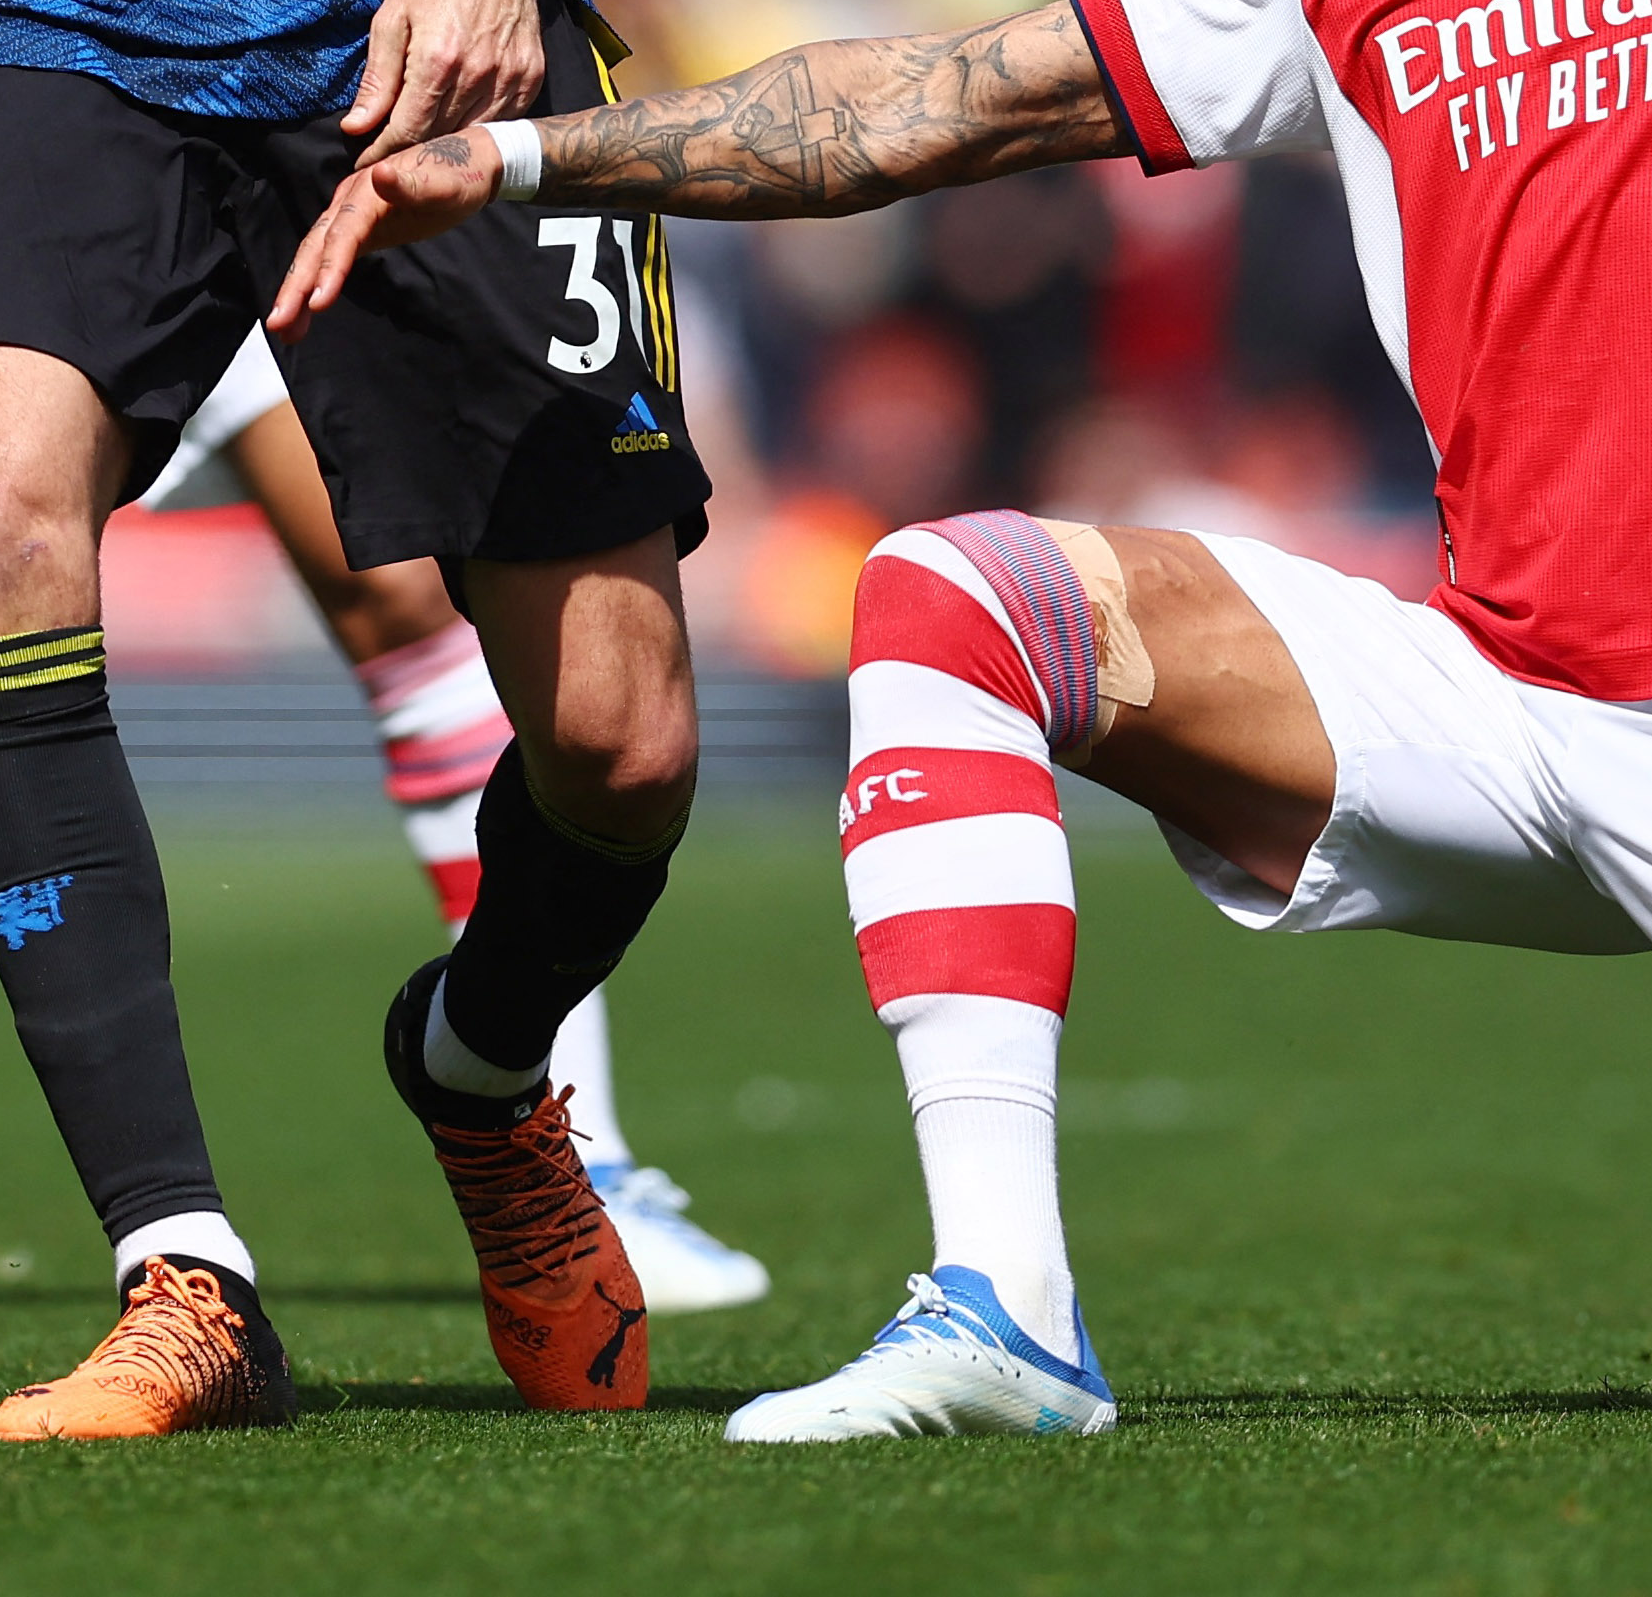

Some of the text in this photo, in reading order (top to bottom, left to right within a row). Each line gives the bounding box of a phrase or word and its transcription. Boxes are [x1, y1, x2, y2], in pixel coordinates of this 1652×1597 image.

[1448, 71, 1525, 173] FLY
[537, 216, 652, 374] 31
[610, 432, 671, 454] adidas
